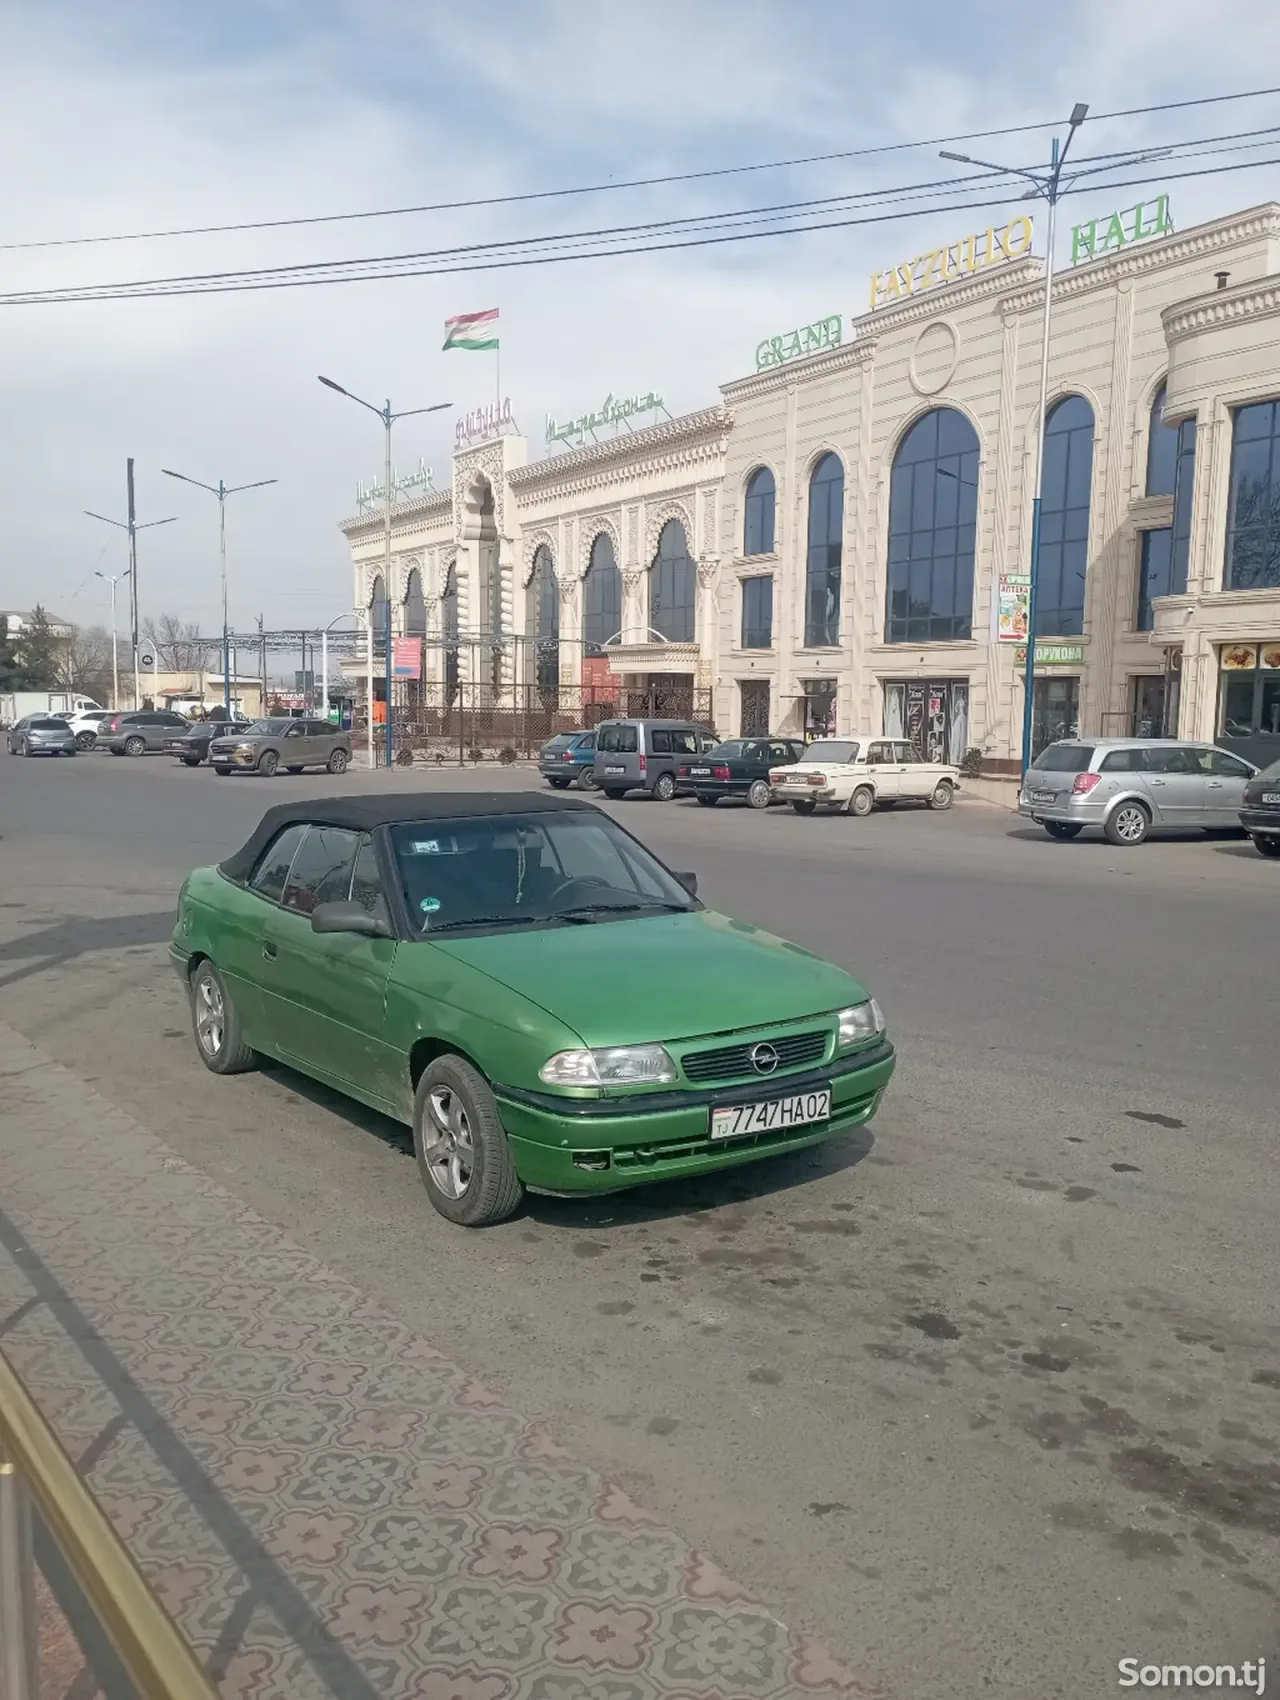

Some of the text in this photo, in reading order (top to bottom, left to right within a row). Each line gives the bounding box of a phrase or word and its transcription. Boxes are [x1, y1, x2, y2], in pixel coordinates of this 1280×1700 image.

[755, 193, 1174, 368] GRAND FAYZULLO HALL
[1001, 585, 1028, 593] АПТЕКА
[1034, 646, 1082, 661] ОРУХОНА
[717, 1092, 828, 1134] TJ 7747HA02
